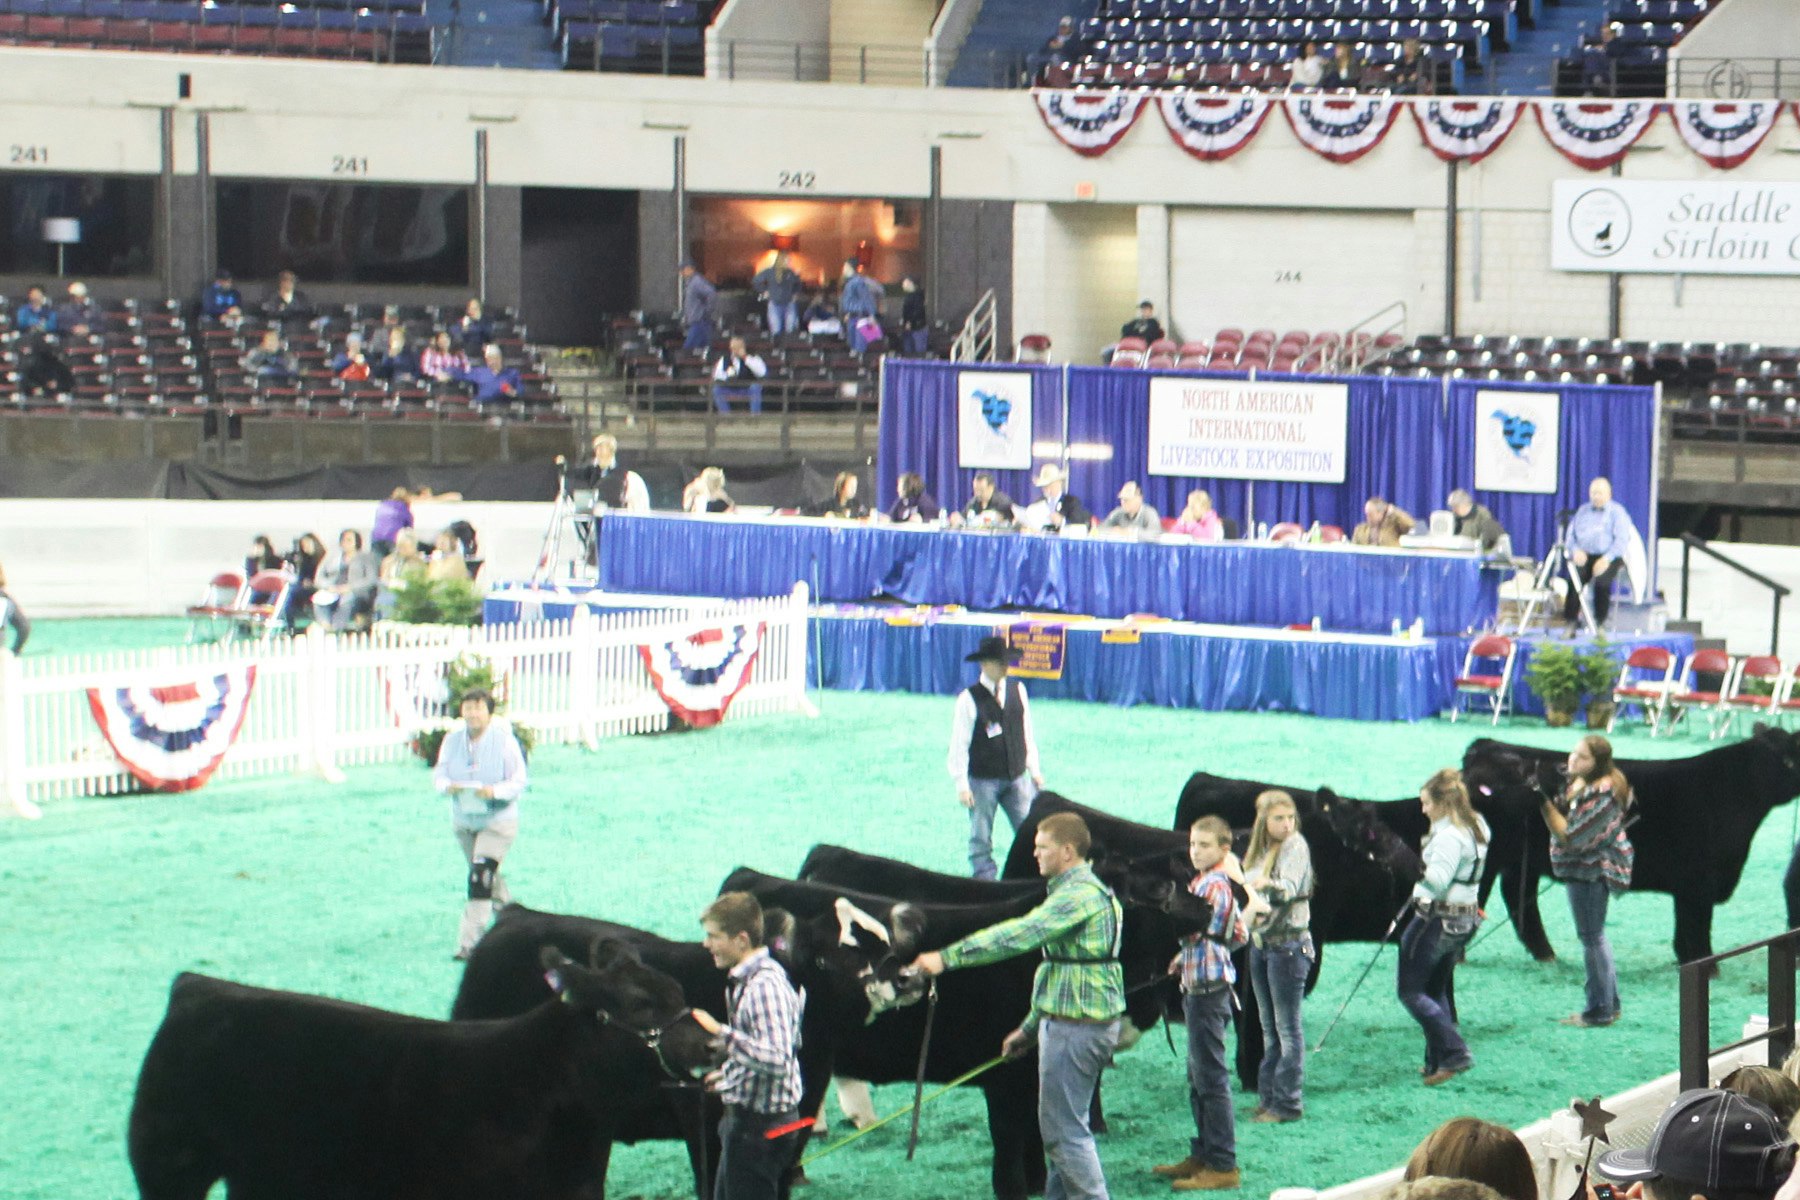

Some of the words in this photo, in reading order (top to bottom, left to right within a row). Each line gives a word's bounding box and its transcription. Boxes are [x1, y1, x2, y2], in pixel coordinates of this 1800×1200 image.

[10, 146, 48, 163] 241
[332, 156, 368, 174] 241
[779, 171, 816, 188] 242
[1669, 190, 1791, 224] Saddle
[1653, 226, 1768, 260] Sirloin
[1182, 388, 1230, 411] NORTH
[1236, 391, 1315, 415] AMERICAN
[1188, 418, 1306, 443] INTERNATIONAL
[1160, 445, 1240, 469] LIVESTOCK
[1246, 448, 1334, 473] EXPOSITION
